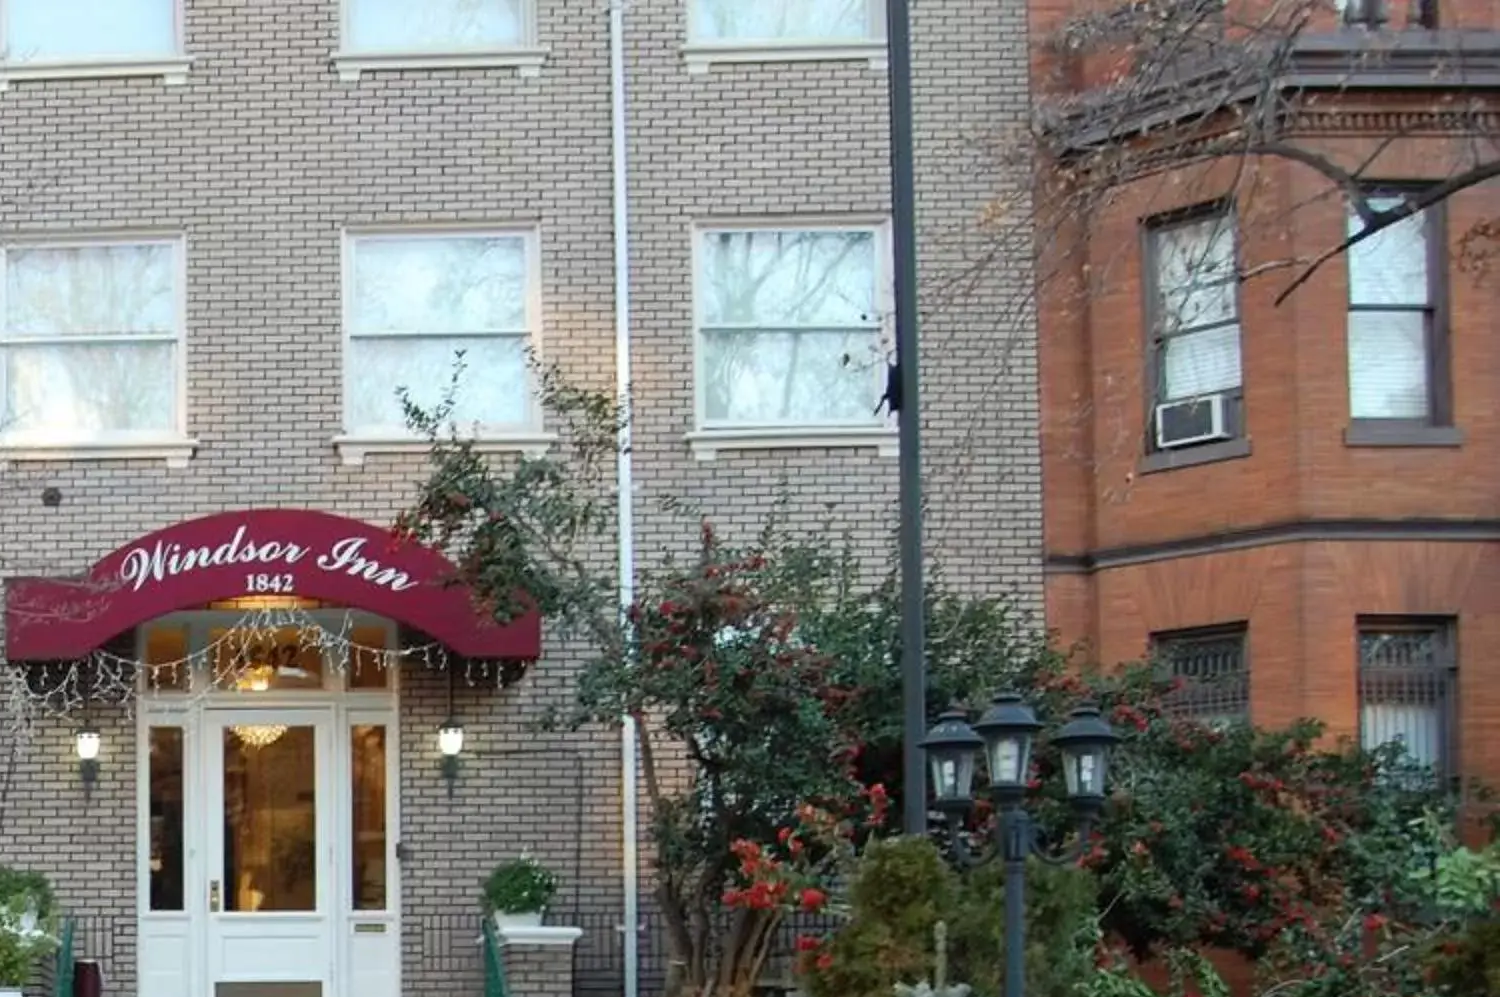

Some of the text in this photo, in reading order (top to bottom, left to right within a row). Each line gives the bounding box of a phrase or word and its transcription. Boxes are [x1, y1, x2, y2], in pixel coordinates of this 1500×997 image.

[121, 526, 419, 591] Windsor Inn
[246, 574, 293, 592] 1842
